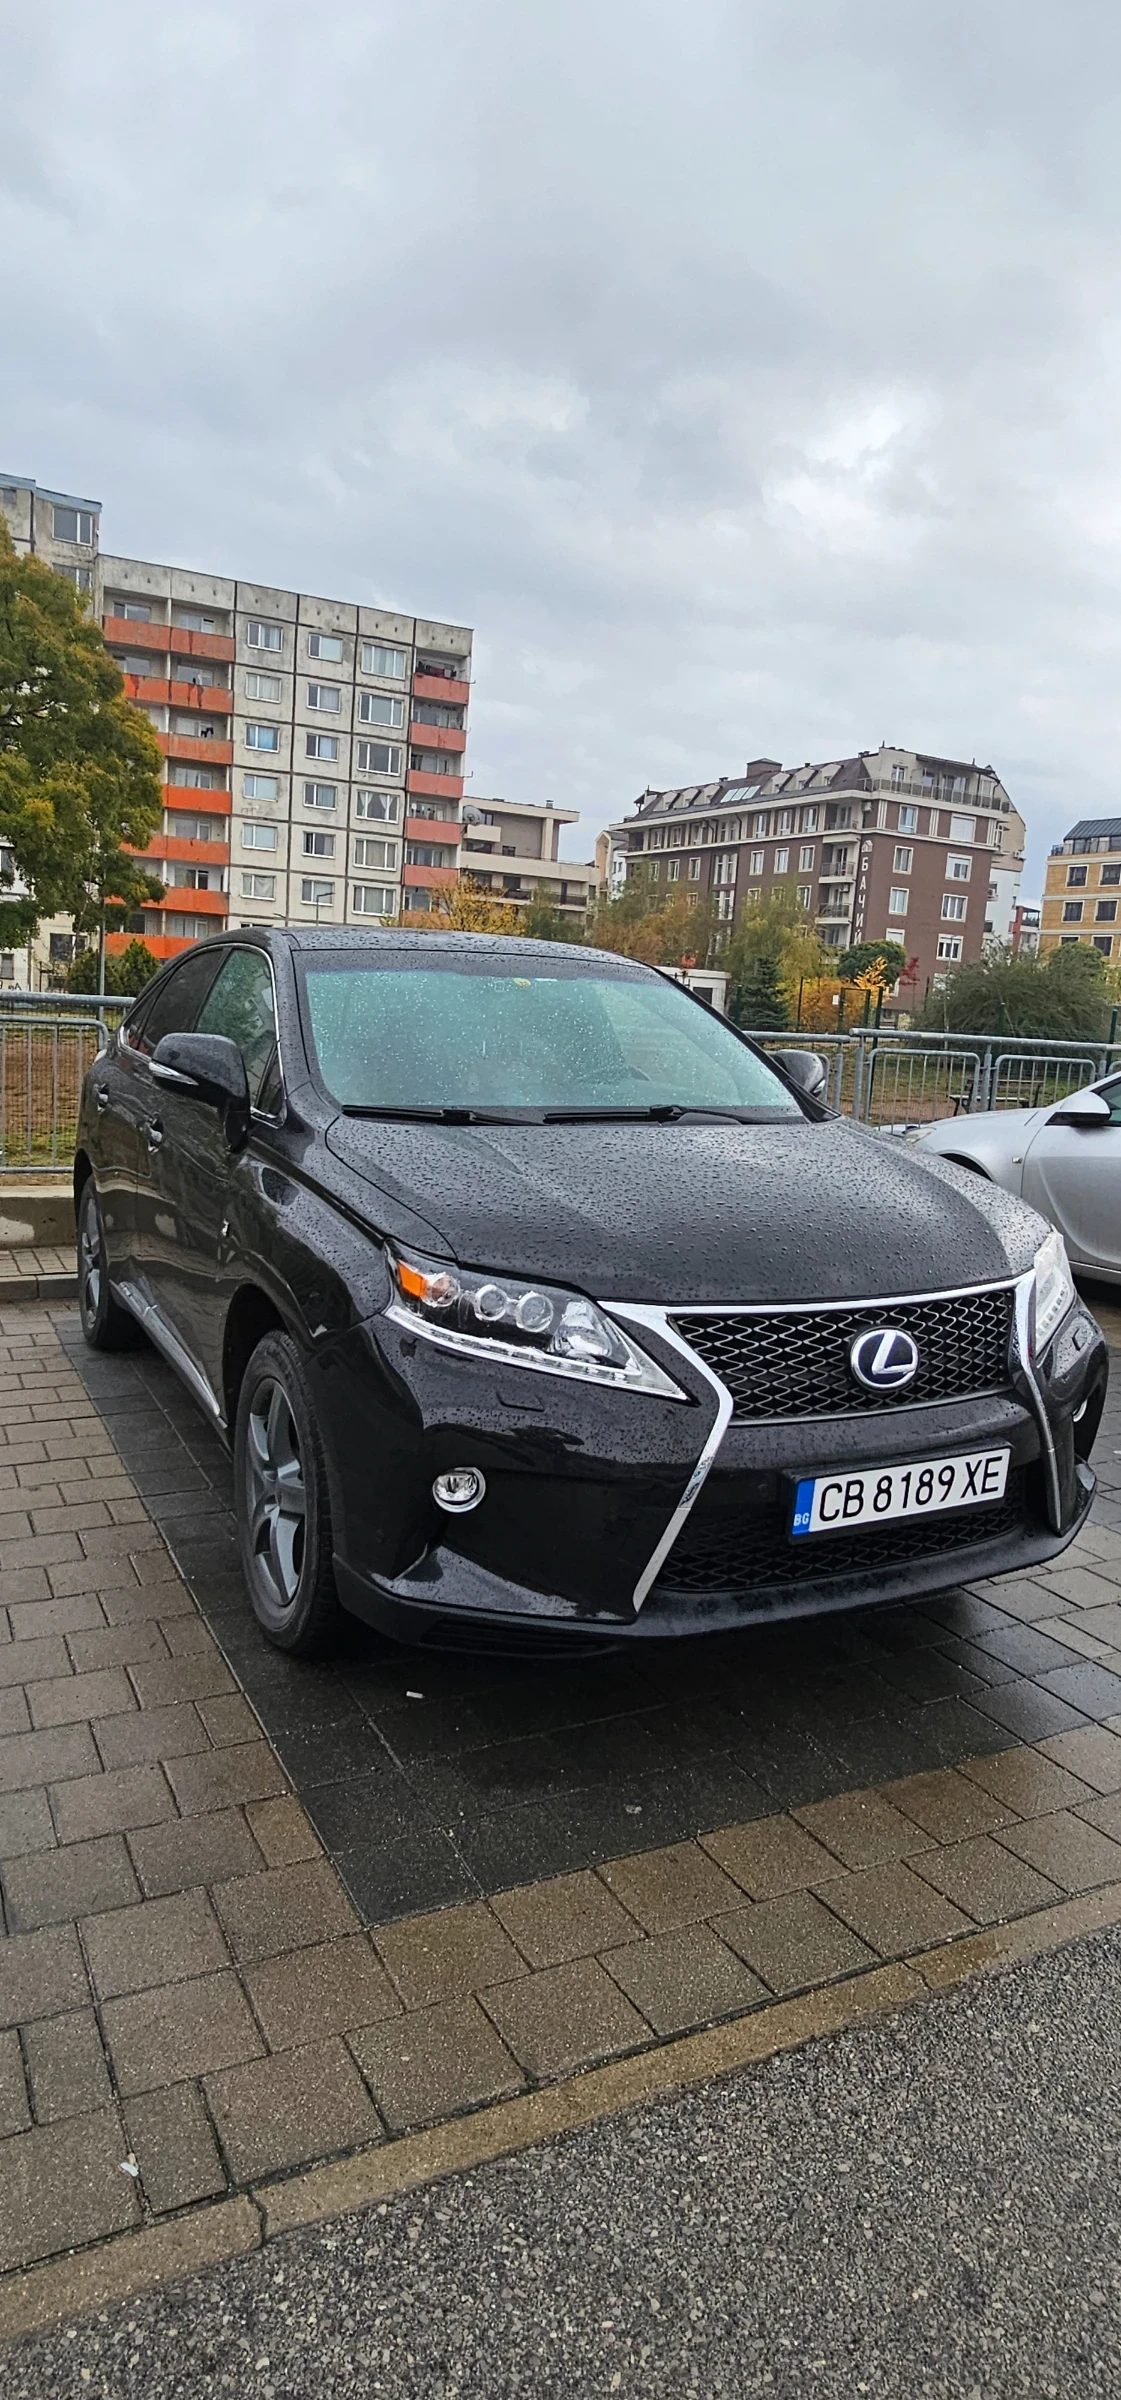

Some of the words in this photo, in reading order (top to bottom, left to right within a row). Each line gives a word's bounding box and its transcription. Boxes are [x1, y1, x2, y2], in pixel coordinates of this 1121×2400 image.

[818, 1478, 865, 1522] CB
[873, 1465, 955, 1513] 8189
[960, 1455, 1003, 1499] XE
[793, 1512, 810, 1527] BG
